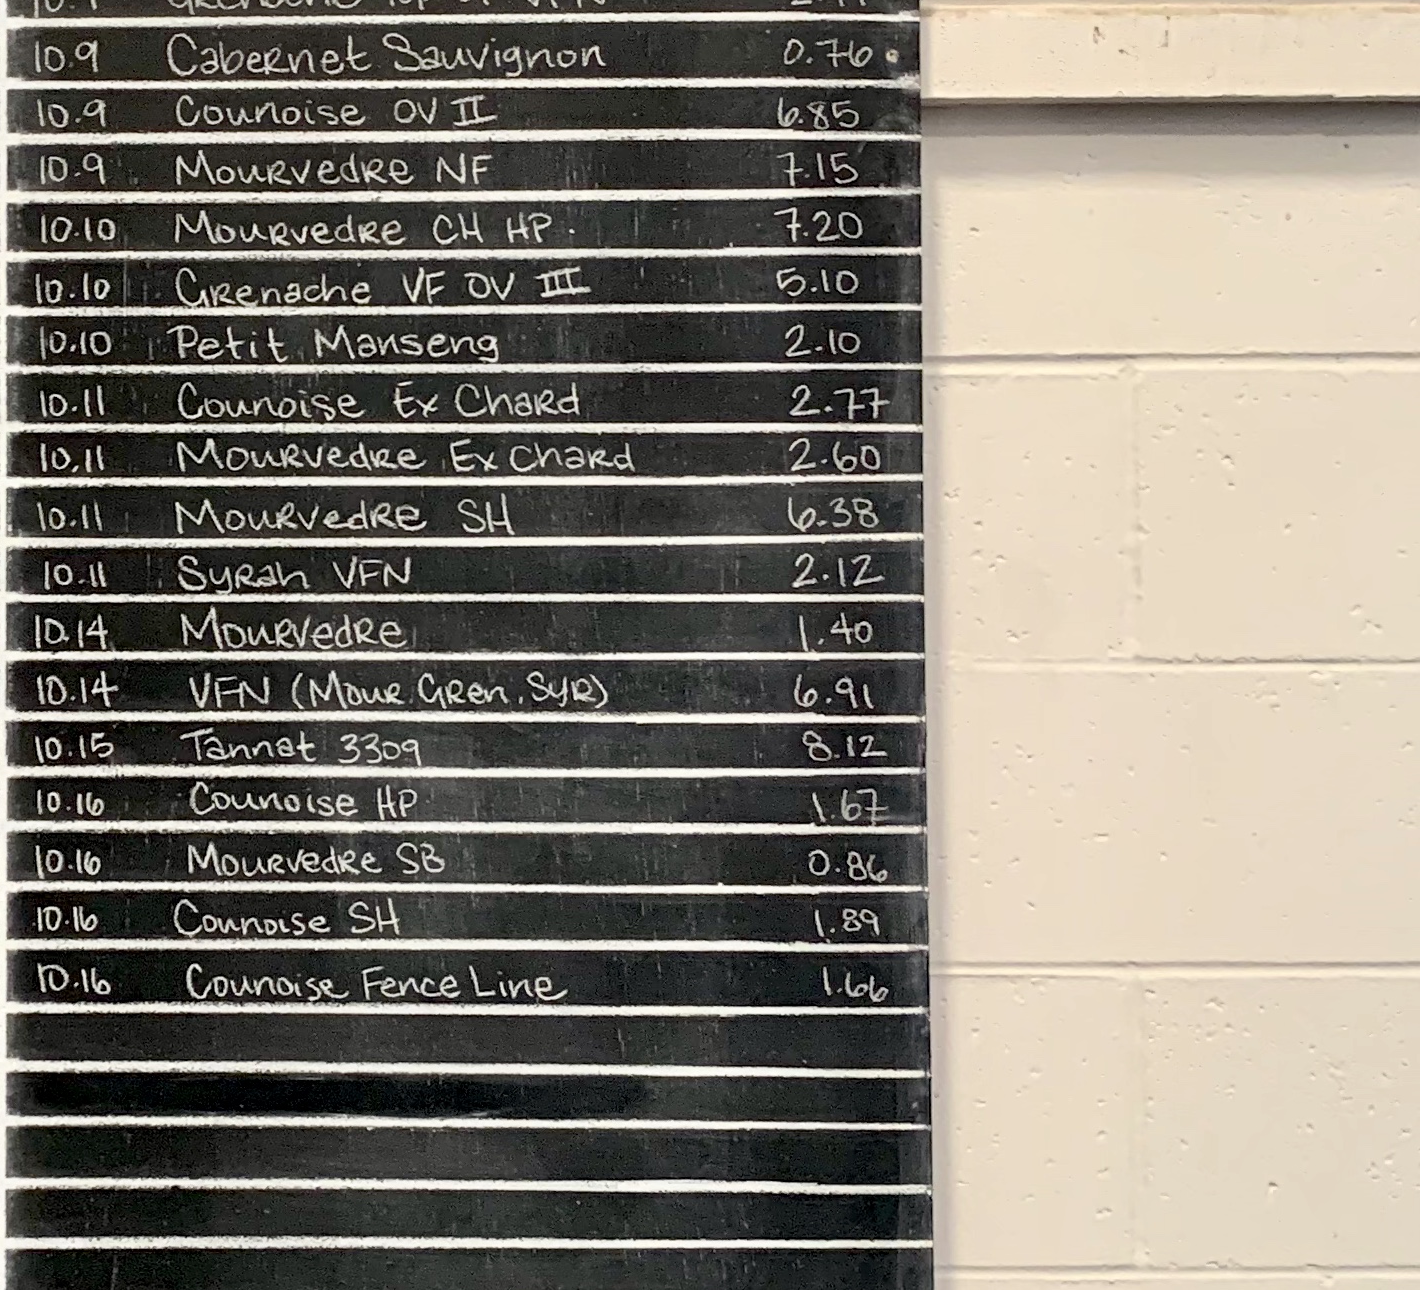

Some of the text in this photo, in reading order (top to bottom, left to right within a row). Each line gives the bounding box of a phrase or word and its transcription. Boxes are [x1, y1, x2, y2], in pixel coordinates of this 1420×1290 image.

[35, 41, 98, 72] 10.9
[383, 33, 605, 77] Sauvignon
[38, 95, 859, 129] 10.9 Counoise OV II 6.85
[41, 325, 860, 363] 10.10 Petit Manseng 2.10
[35, 728, 886, 766] 10.15 Tannat 3309 8.12
[37, 898, 879, 938] 10.16 Counoise SH 1.89
[38, 964, 111, 994] 10.16
[186, 964, 349, 1001] Counoise
